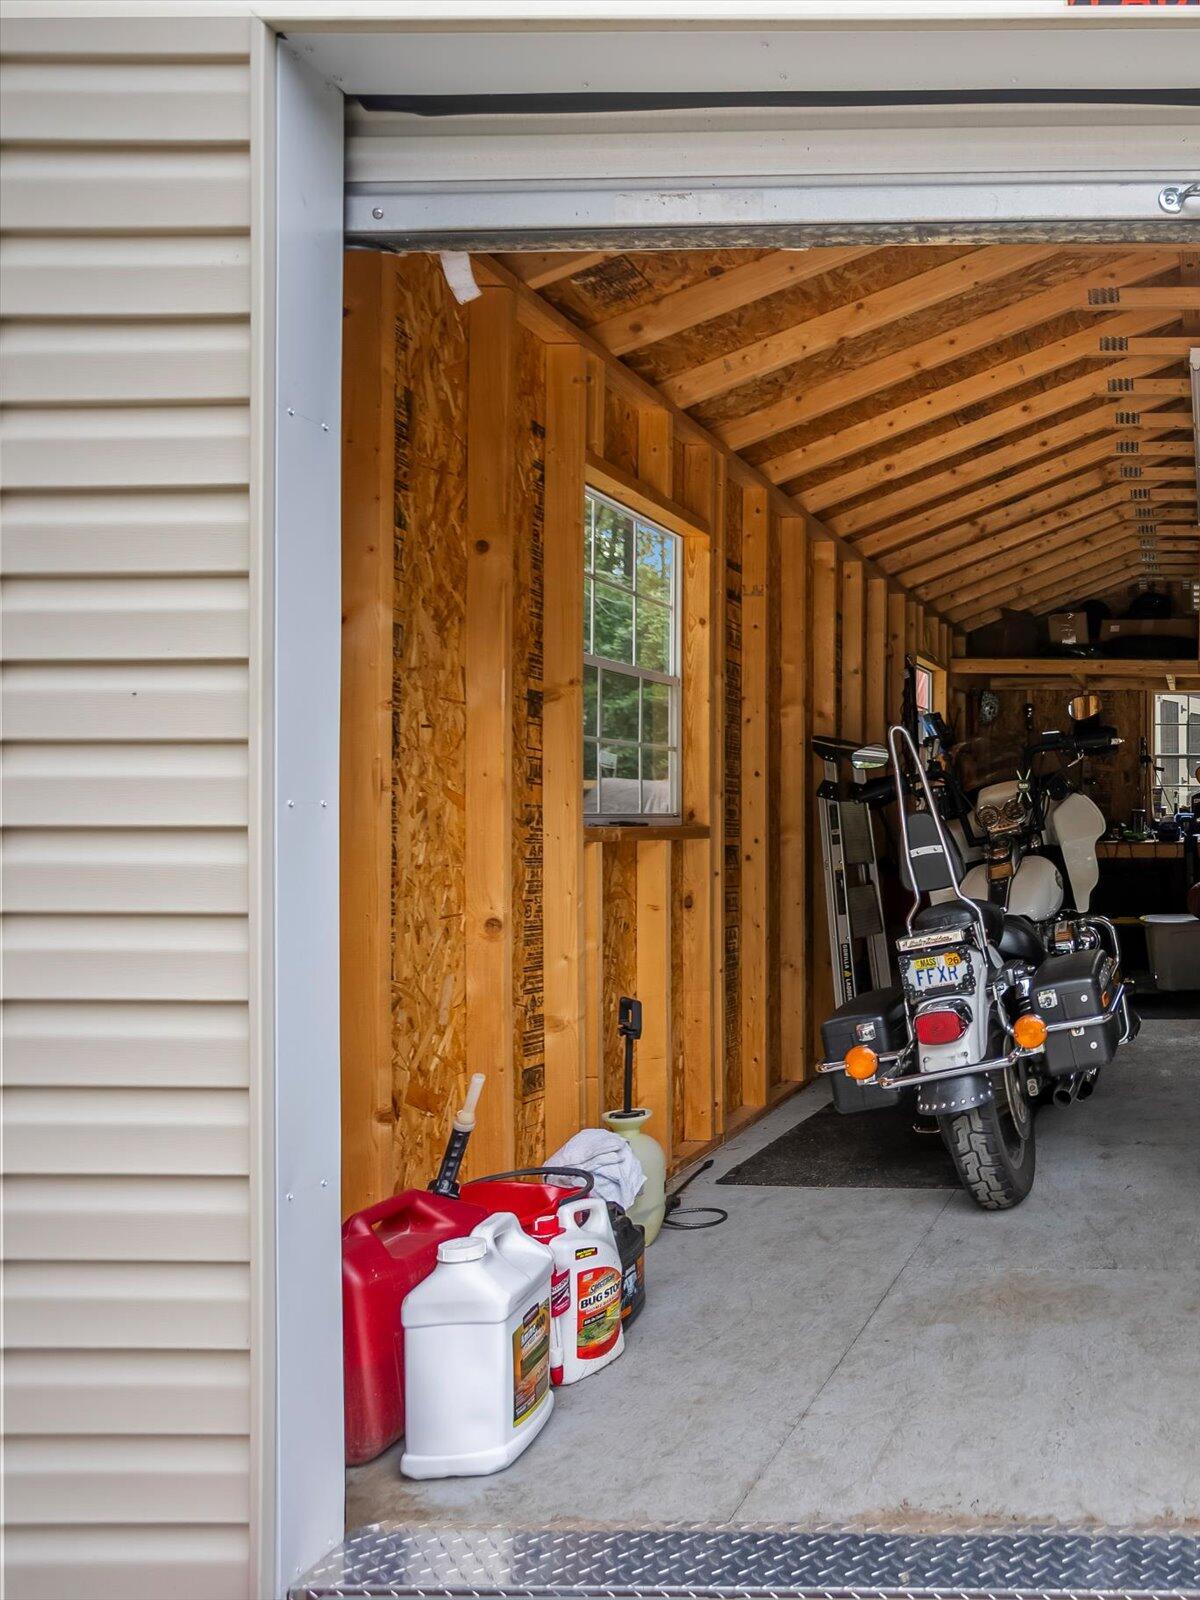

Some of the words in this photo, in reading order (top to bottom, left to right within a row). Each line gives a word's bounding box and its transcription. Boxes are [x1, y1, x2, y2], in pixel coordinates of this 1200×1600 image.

[920, 957, 936, 968] MASS
[947, 956, 959, 966] 26
[580, 1291, 603, 1309] BUG
